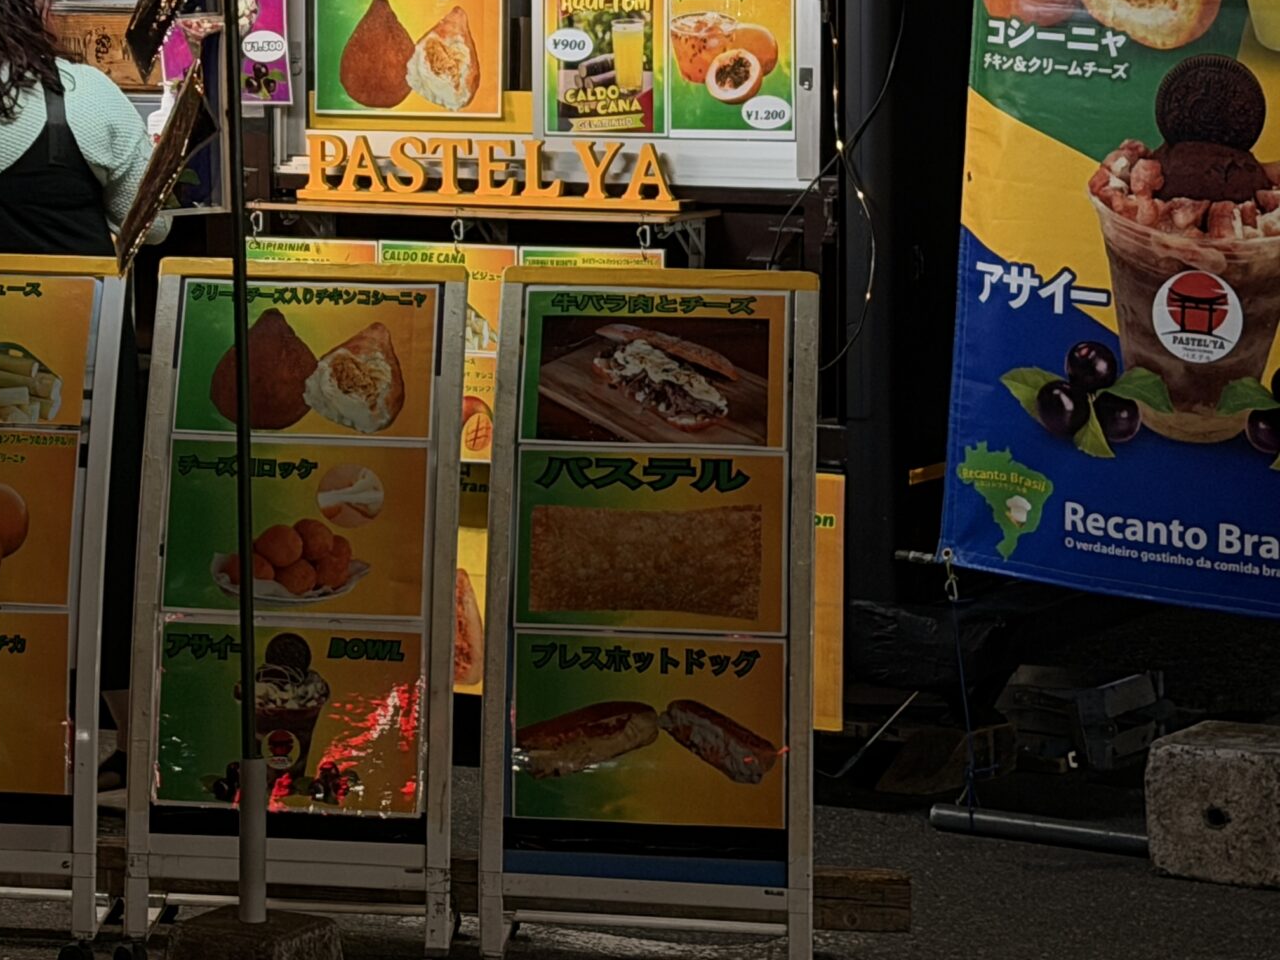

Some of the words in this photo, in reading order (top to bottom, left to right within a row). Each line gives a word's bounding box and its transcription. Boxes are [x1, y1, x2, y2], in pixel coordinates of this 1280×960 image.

[244, 41, 284, 52] ¥1.500
[552, 39, 586, 51] ¥900
[987, 18, 1127, 58] コシーニャ
[983, 52, 1129, 80] チキン&クリームチーズ
[564, 85, 620, 103] CALDO
[596, 97, 642, 115] CANA
[746, 108, 786, 121] ¥1.200
[248, 240, 311, 252] CAIPIRINHA
[382, 249, 418, 263] CALDO
[421, 251, 434, 263] DE
[436, 252, 466, 265] CANA
[190, 283, 427, 308] クリーチーズ入りチキンコシーニャ
[975, 260, 1110, 315] アサイー
[551, 293, 757, 316] 牛バラ肉とチーズ
[1172, 335, 1226, 350] PASTEL'YA
[535, 456, 751, 492] パステル
[961, 468, 1008, 481] Recanto
[1010, 471, 1048, 493] Brasil
[1064, 501, 1208, 551] Recanto
[1065, 537, 1075, 548] O
[1076, 539, 1139, 559] verdadeiro
[1141, 547, 1194, 567] gostinho
[1195, 554, 1212, 569] da
[1214, 557, 1260, 576] comida
[327, 637, 406, 662] BOWL
[530, 641, 761, 678] プレスホットドッグ
